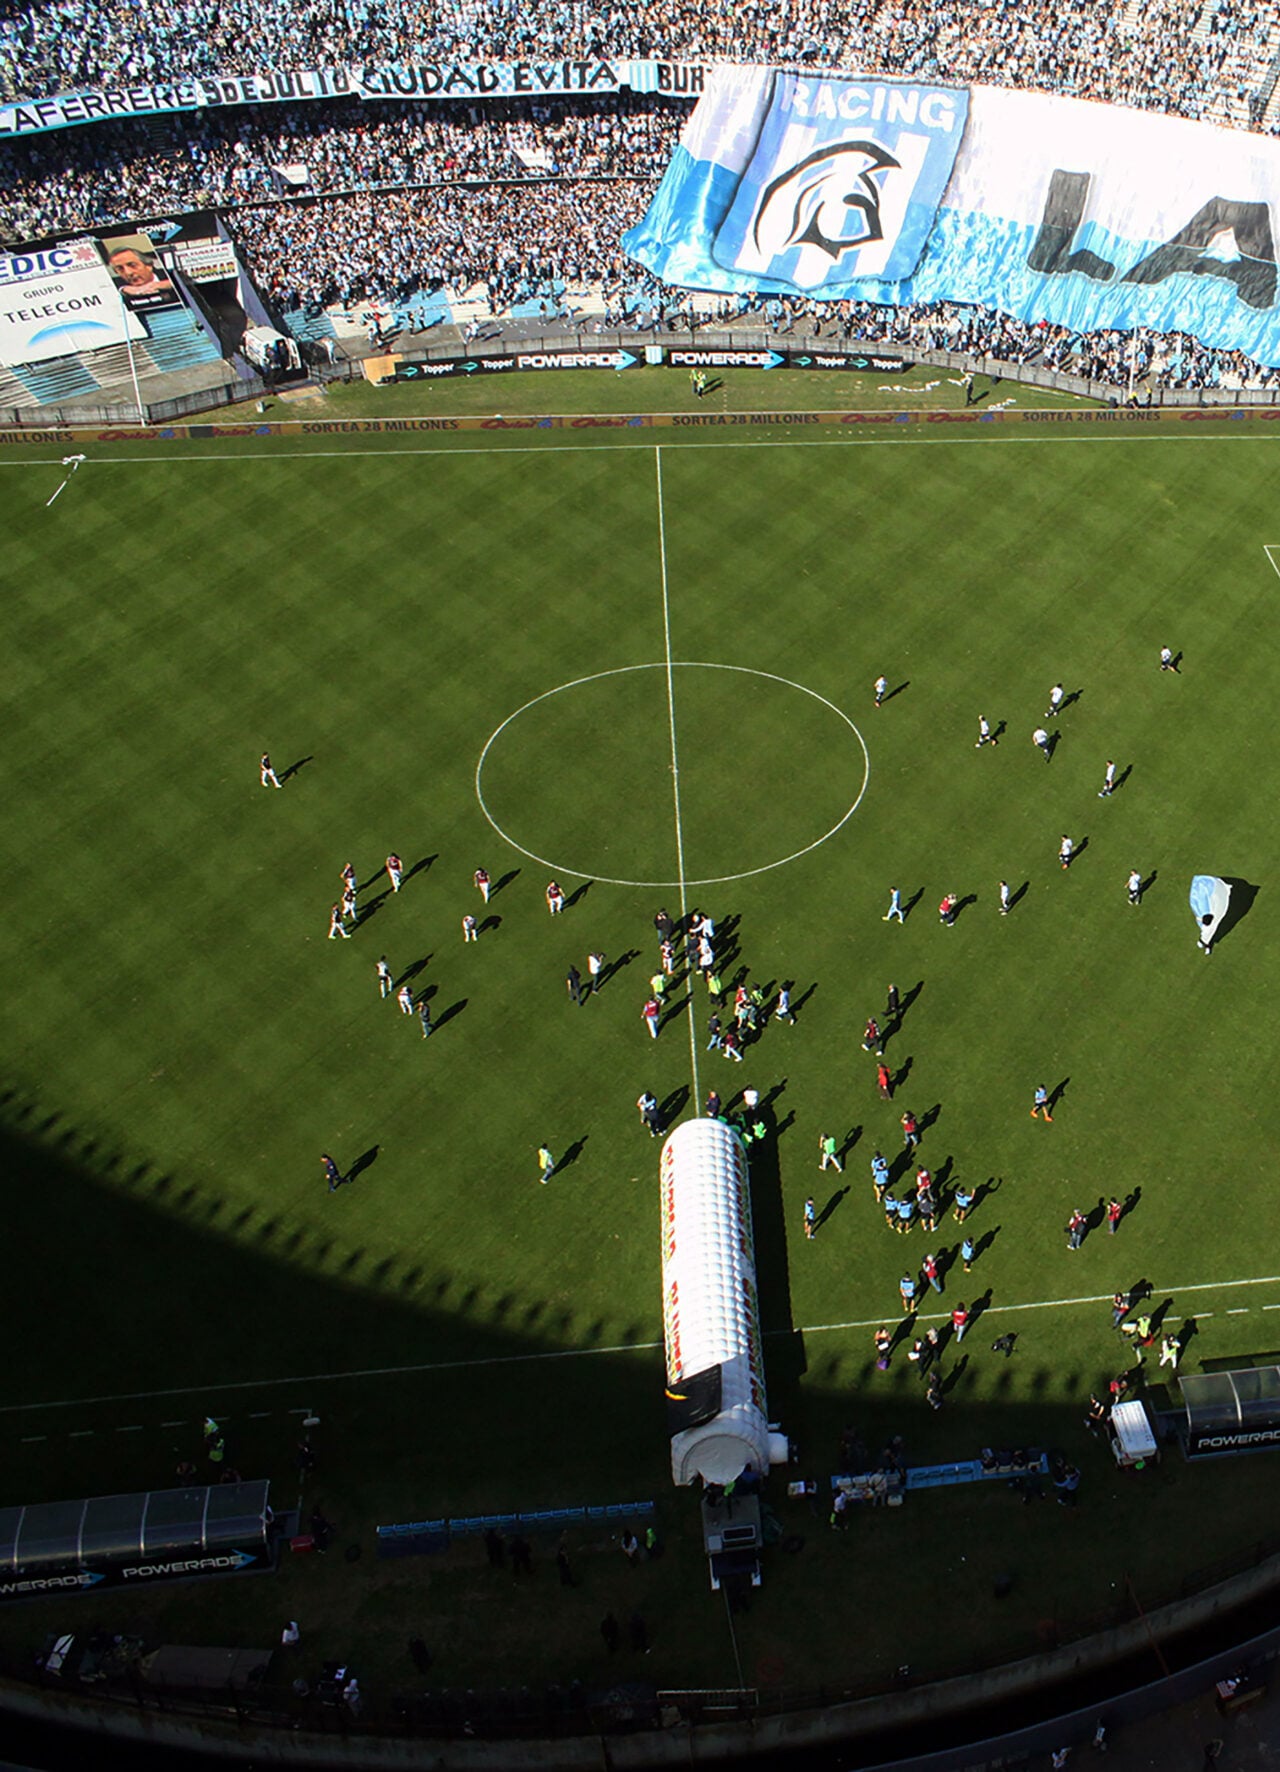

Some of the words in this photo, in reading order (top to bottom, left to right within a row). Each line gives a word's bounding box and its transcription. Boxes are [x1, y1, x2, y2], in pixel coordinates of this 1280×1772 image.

[360, 65, 500, 94] CIUDAD
[513, 61, 618, 91] EVITA
[780, 83, 956, 132] RACING
[1027, 168, 1279, 309] LA
[23, 285, 64, 299] GRUPO
[4, 294, 102, 324] TELECOM
[421, 363, 455, 375] Topper
[482, 359, 514, 370] Topper
[518, 353, 623, 368] POWERADE
[671, 352, 772, 365] POWERADE
[816, 356, 846, 367] Topper
[873, 359, 902, 370] Topper
[303, 421, 359, 434] SORTEA
[363, 421, 381, 432] 28
[385, 419, 459, 432] MILLONES
[672, 415, 727, 426] SORTEA
[730, 415, 747, 425] 28
[750, 413, 820, 425] MILLONES
[1022, 411, 1073, 422] SORTEA
[1077, 411, 1093, 421] 28
[1096, 410, 1161, 422] MILLONES
[122, 1554, 244, 1578] POWERADE
